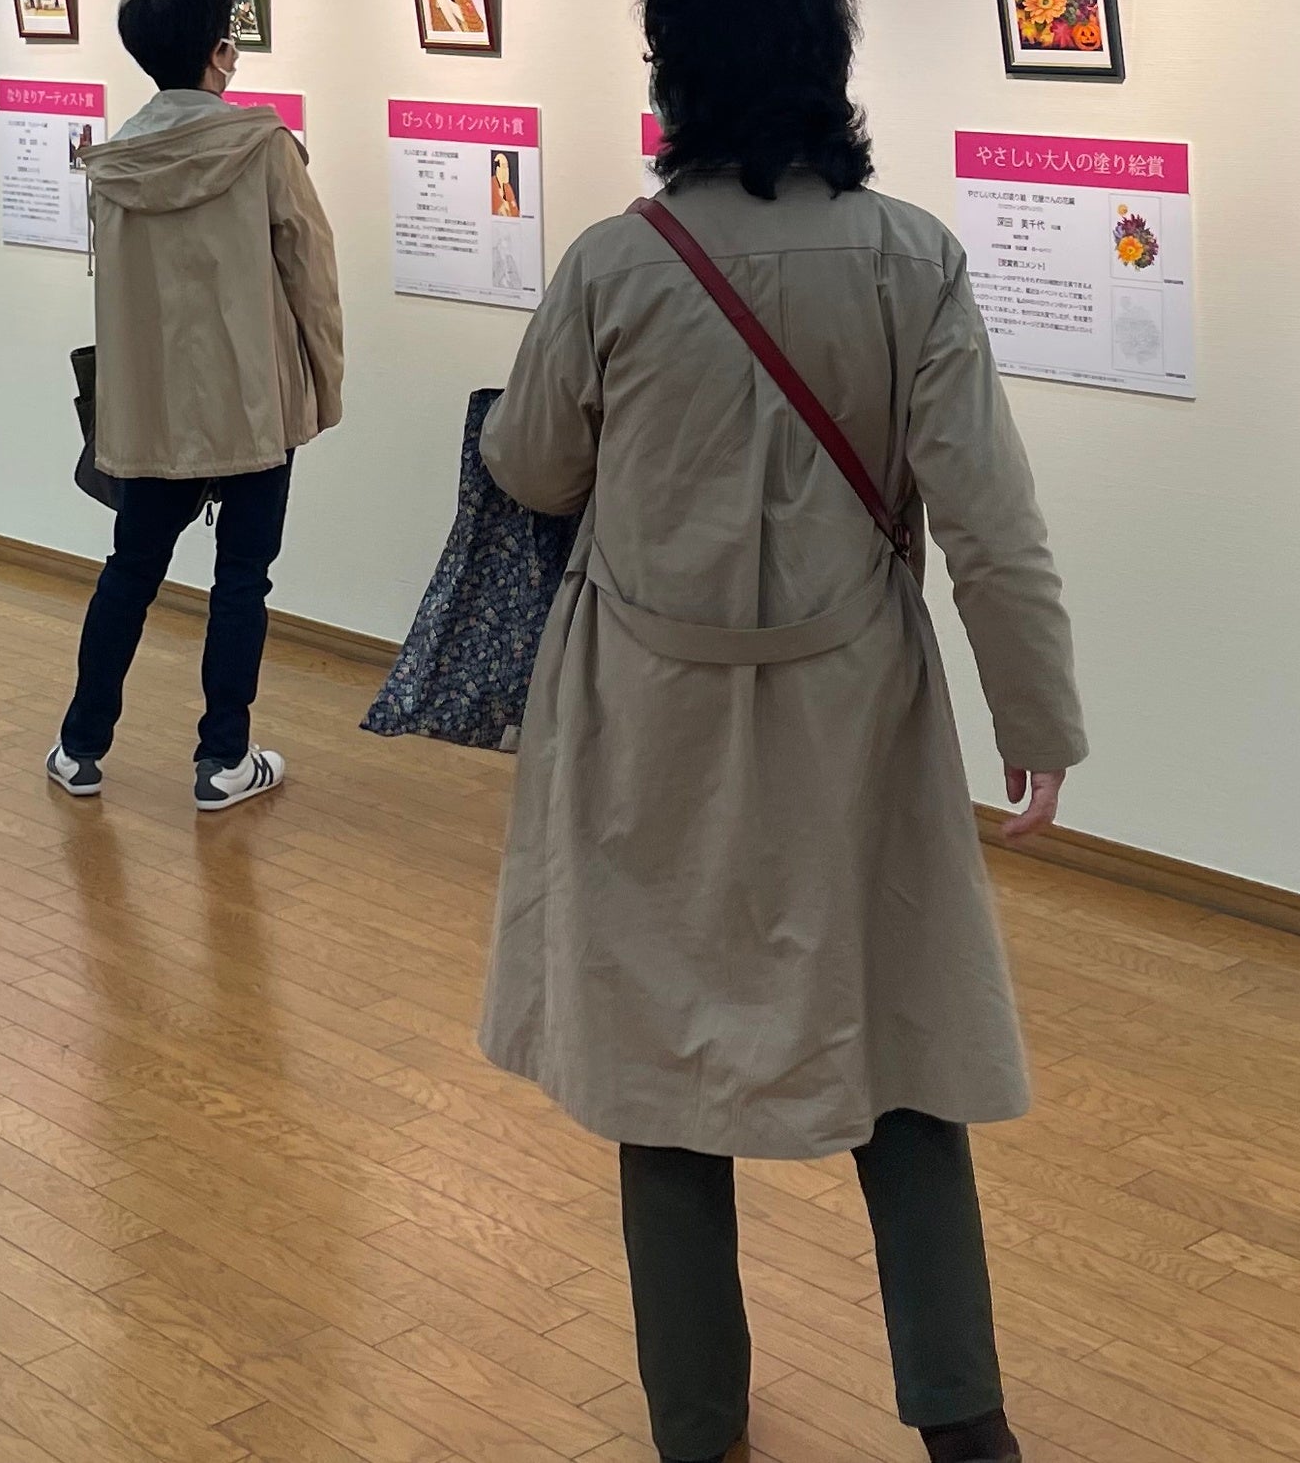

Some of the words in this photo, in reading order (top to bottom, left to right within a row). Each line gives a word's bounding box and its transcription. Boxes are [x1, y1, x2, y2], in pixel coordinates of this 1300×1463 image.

[6, 87, 95, 108] なりきりアーティスト賞
[401, 111, 525, 136] びっくり！インパクト賞
[975, 145, 1165, 179] やさしい大人の塗り絵賞
